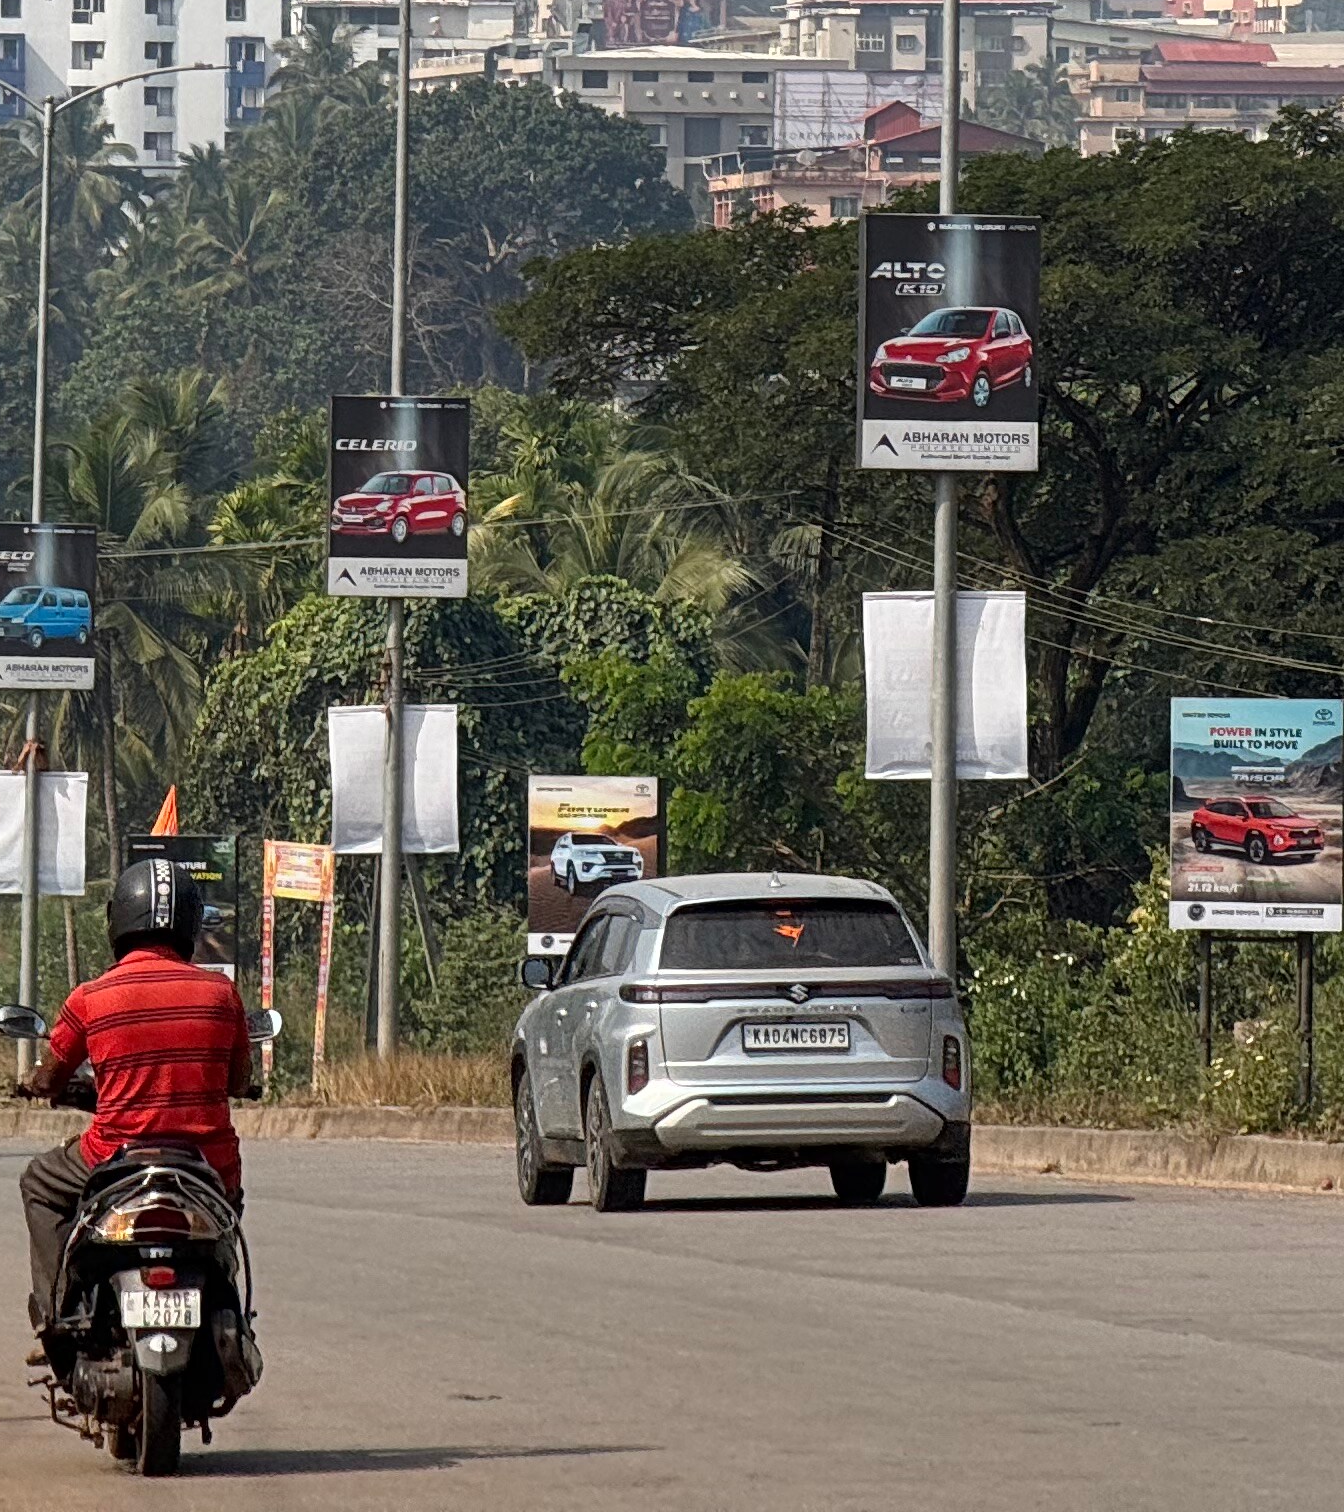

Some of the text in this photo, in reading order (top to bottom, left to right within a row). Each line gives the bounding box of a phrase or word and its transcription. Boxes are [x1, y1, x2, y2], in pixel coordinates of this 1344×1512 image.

[869, 261, 946, 279] ALTO
[902, 432, 1030, 444] ABHARAN MOTORS
[335, 438, 417, 451] CELERIO
[360, 567, 460, 577] ABHARAN MOTORS
[1209, 727, 1303, 738] POWER IN STYLE
[1213, 740, 1299, 750] BUILT TO MOVE
